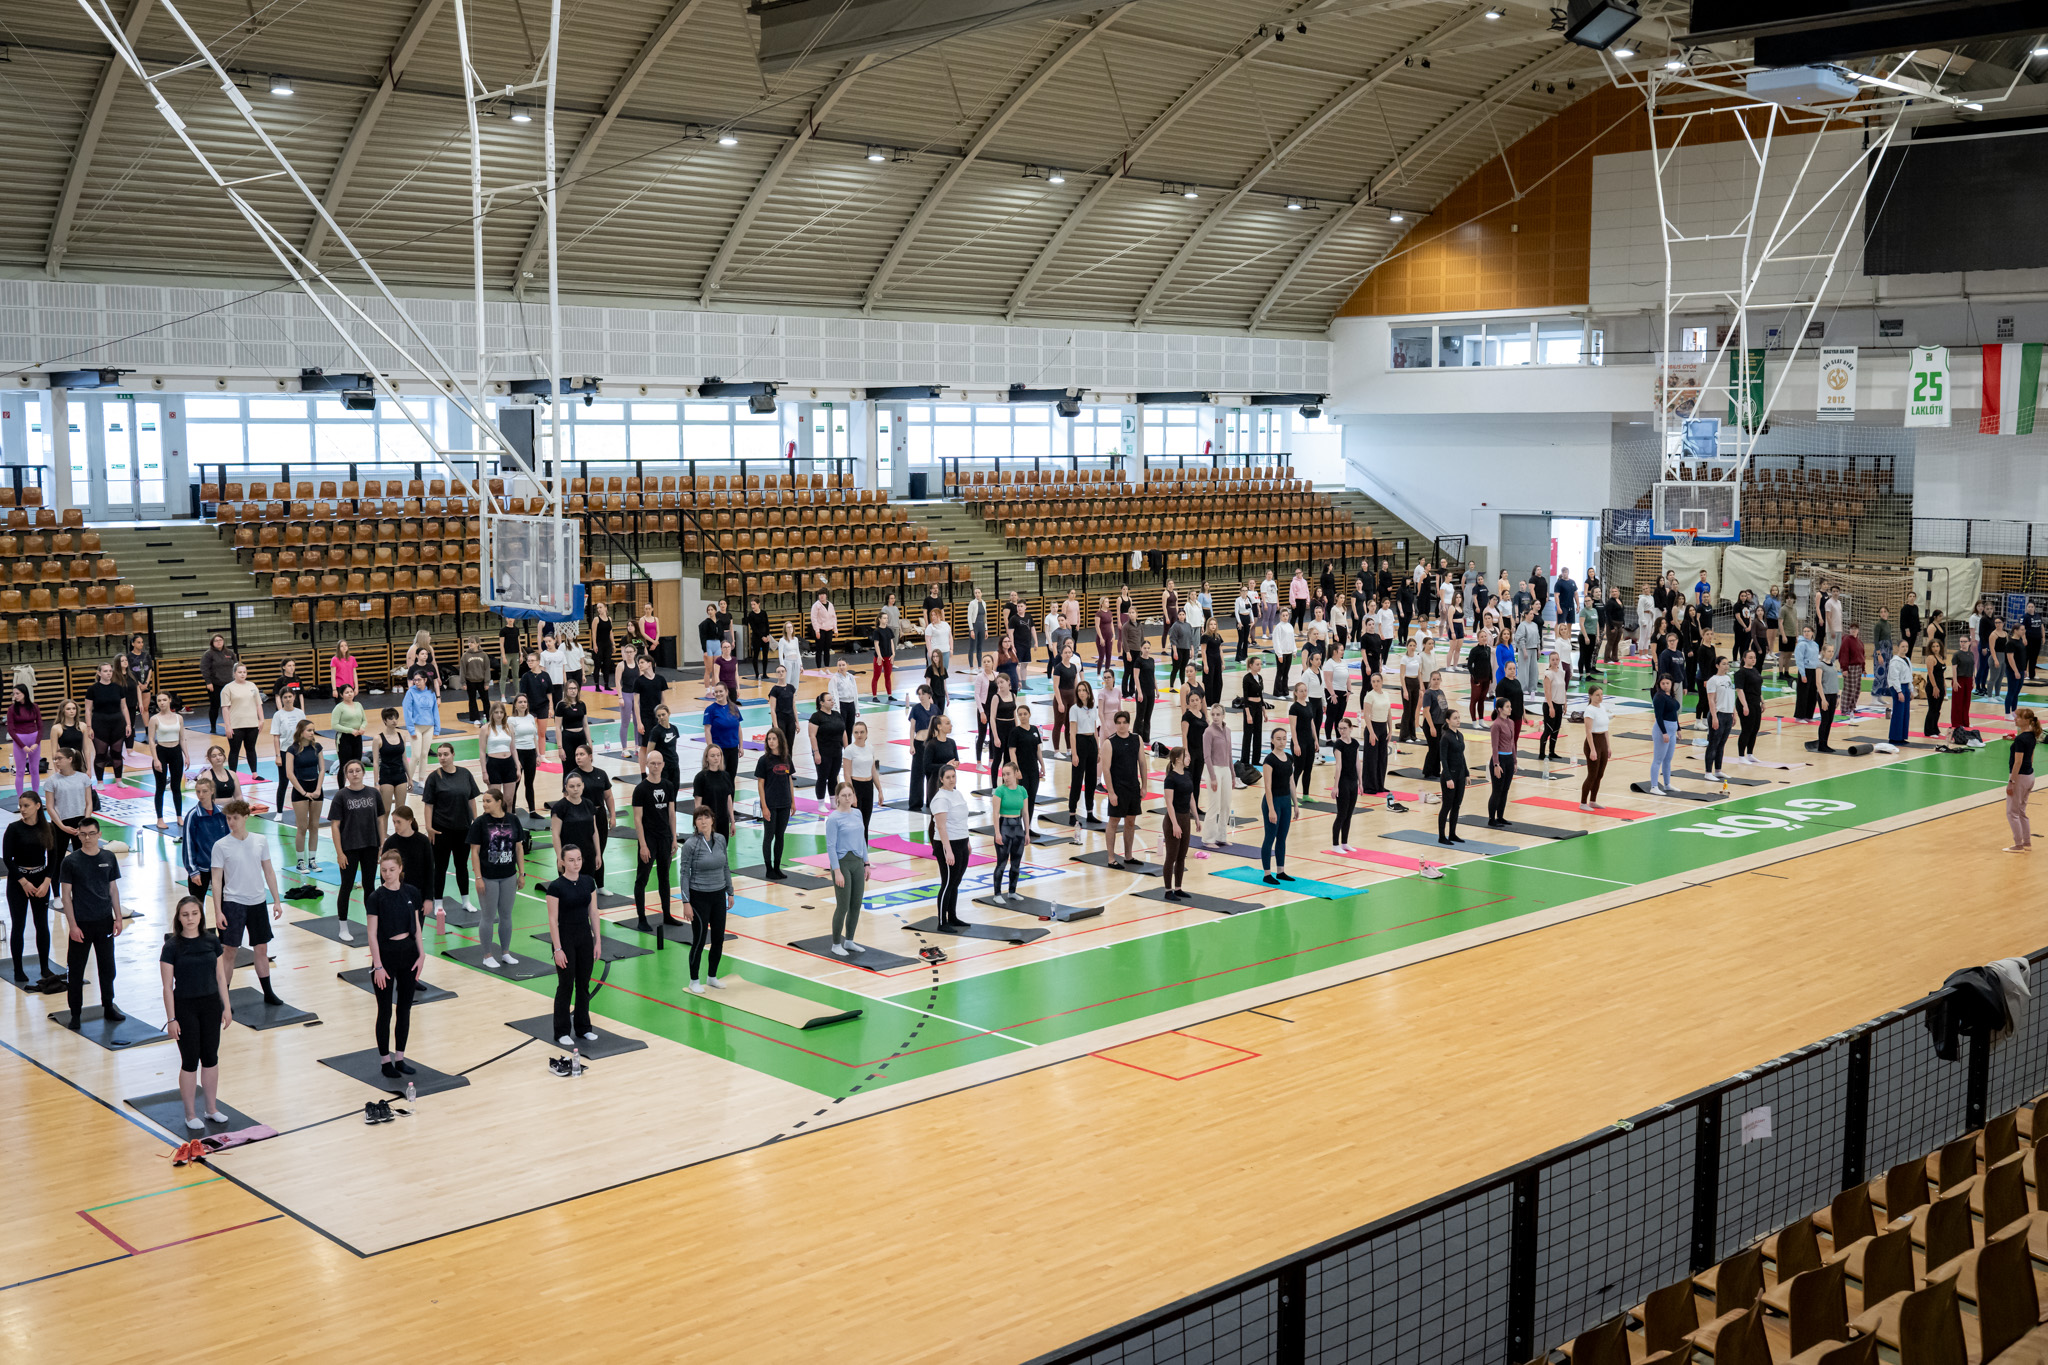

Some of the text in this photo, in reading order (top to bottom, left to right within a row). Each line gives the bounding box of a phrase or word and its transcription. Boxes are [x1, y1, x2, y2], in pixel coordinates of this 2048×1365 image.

[1914, 371, 1942, 402] 25
[1827, 396, 1845, 404] 2012
[1911, 404, 1943, 415] LAKLÓTH
[1123, 416, 1135, 433] D
[1668, 798, 1857, 838] GYŐR
